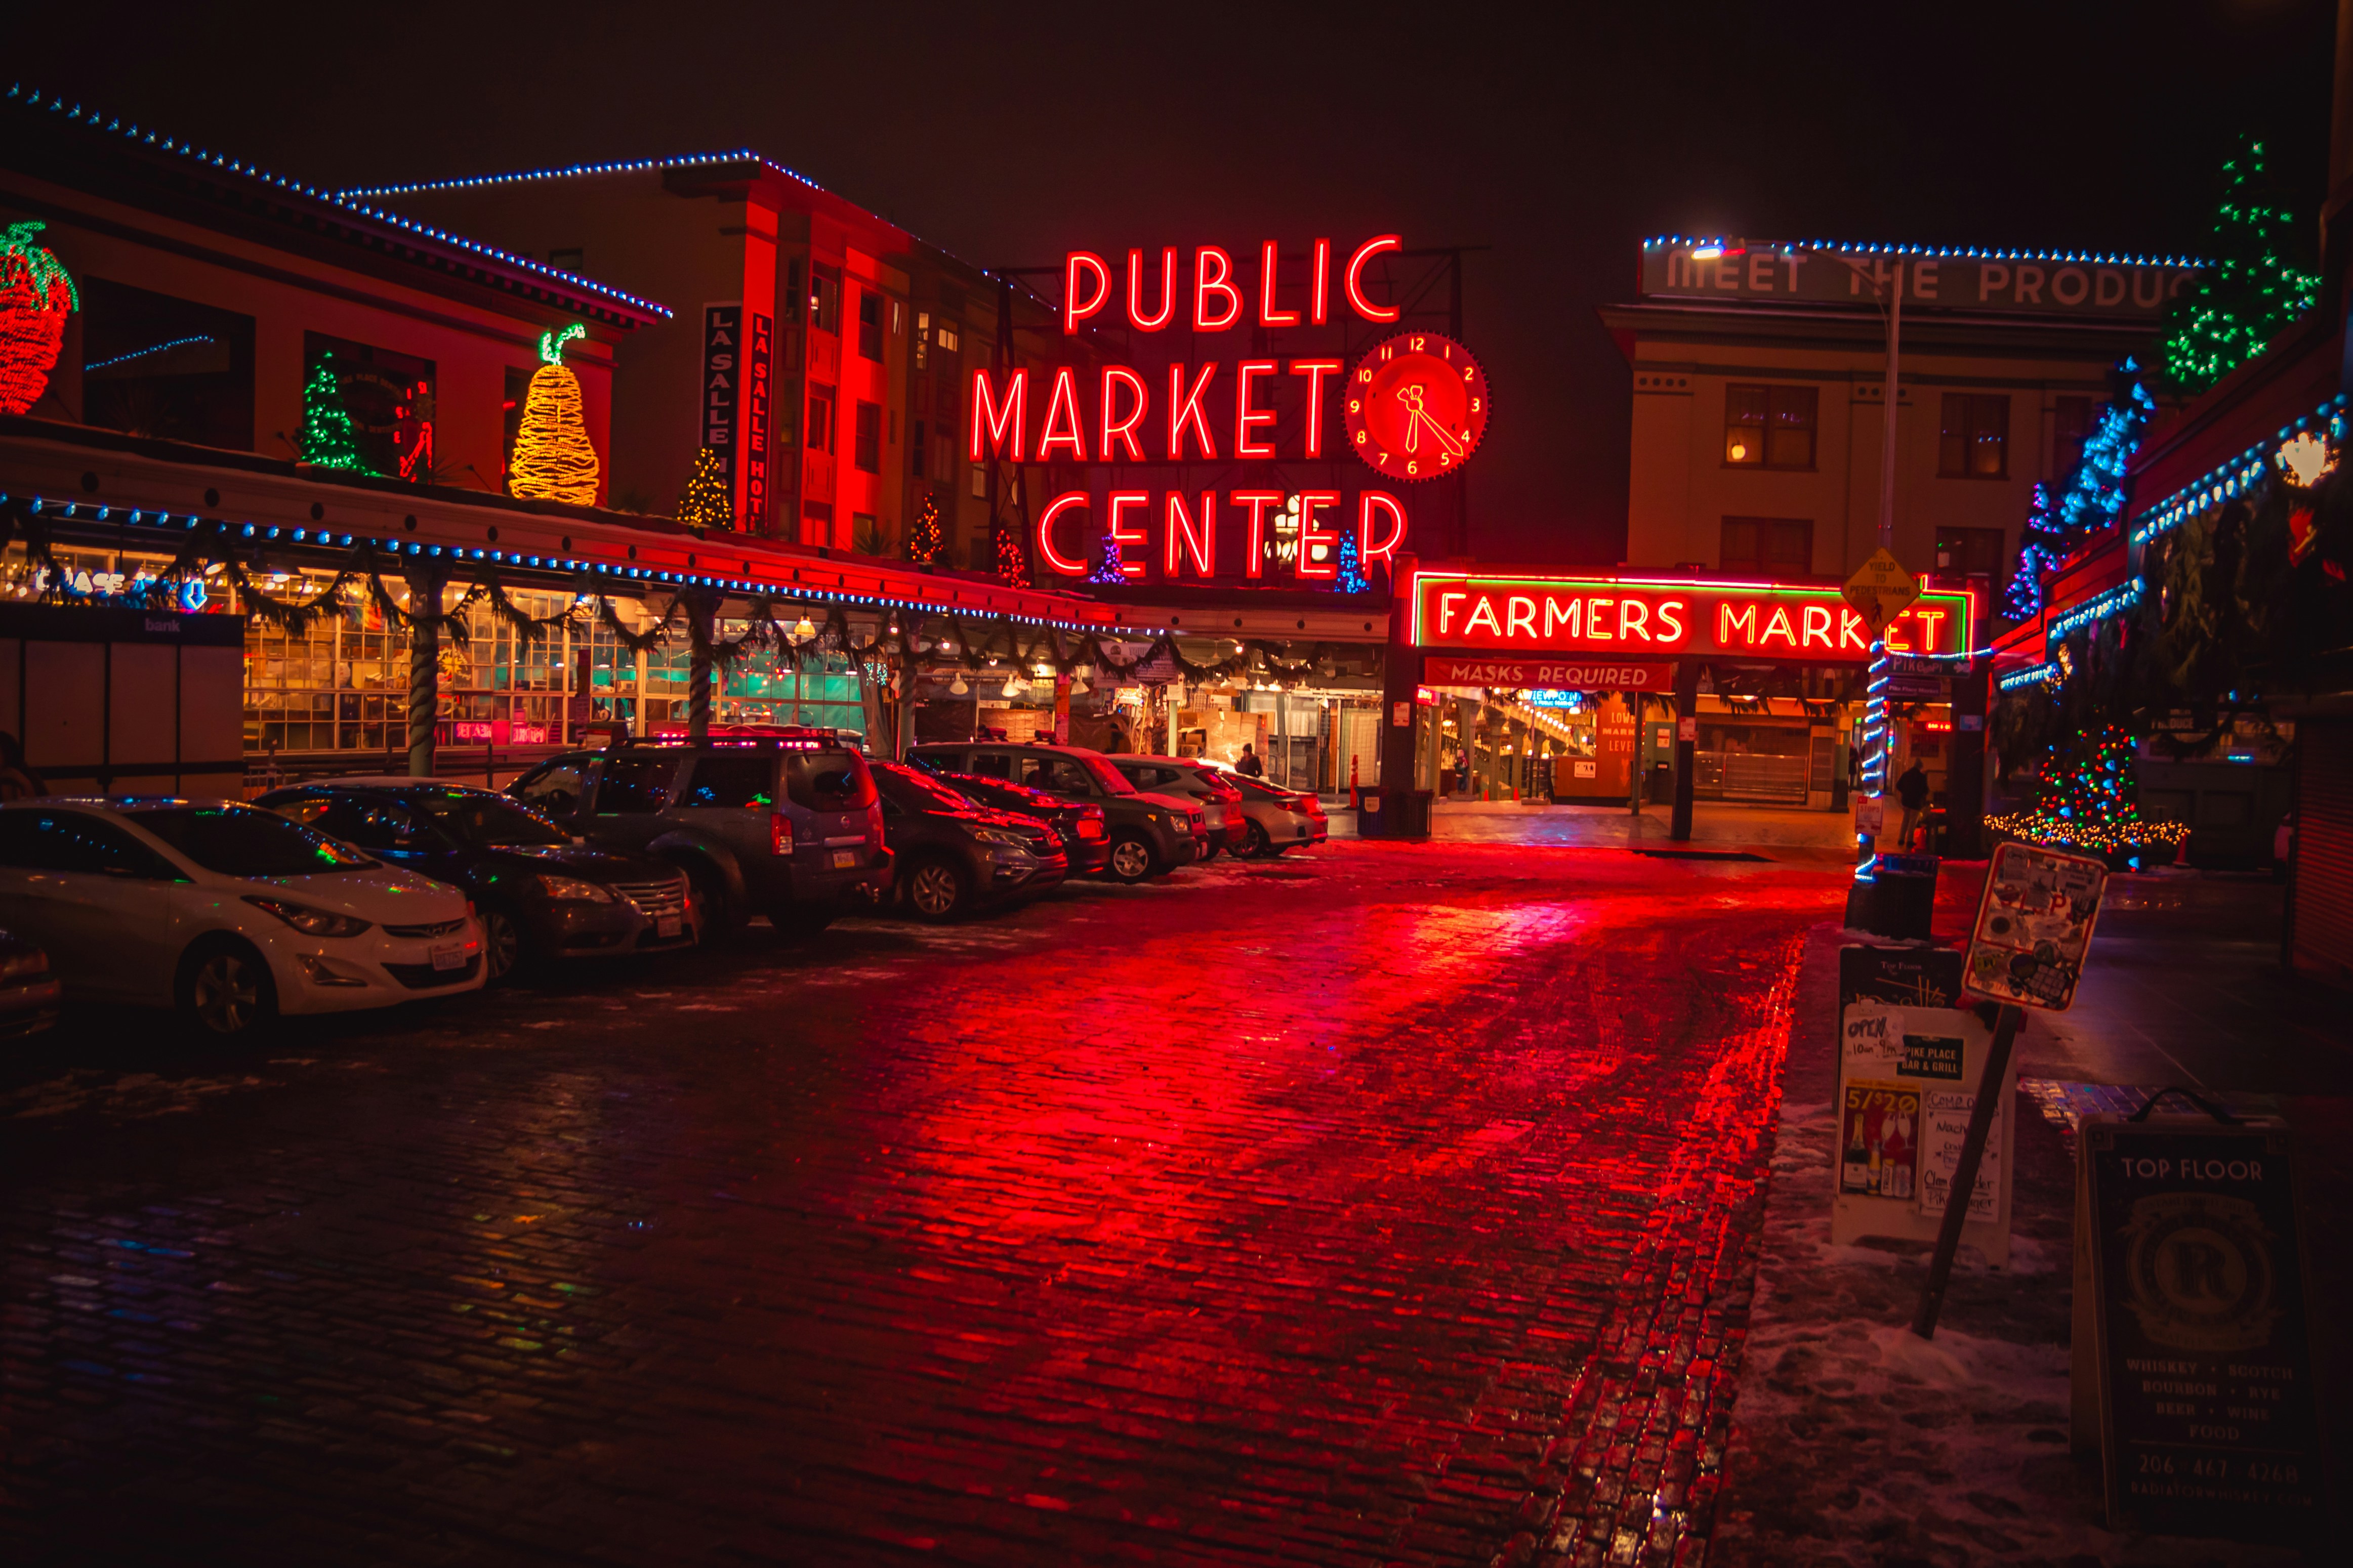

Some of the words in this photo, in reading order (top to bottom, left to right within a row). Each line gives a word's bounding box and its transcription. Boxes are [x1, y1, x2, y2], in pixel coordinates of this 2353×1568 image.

[1668, 249, 1808, 292] MEET
[1841, 257, 1938, 299] THE
[1064, 234, 1402, 335] PUBLIC
[1410, 337, 1424, 351] 12
[1381, 347, 1392, 360] 11
[1446, 346, 1449, 359] 1
[1359, 369, 1372, 383] 10
[1465, 367, 1473, 380] 2
[970, 358, 1344, 462] MARKET
[1350, 400, 1360, 413] 9
[1471, 398, 1480, 412] 3
[1356, 430, 1366, 444] 8
[1461, 430, 1470, 443] 4
[1379, 452, 1388, 465] 7
[1441, 452, 1449, 465] 5
[1408, 460, 1417, 474] 6
[1037, 489, 1408, 580] CENTER
[1869, 561, 1895, 572] YIELD
[1875, 574, 1886, 583] TO
[1850, 585, 1910, 597] PEDESTRIANS
[145, 618, 181, 632] bank
[1440, 592, 1683, 642] FARMERS
[1720, 603, 1945, 652] MARKET
[1893, 657, 1923, 672] Pike
[1452, 664, 1523, 682] MASKS
[1538, 666, 1648, 687] REQUIRED
[1611, 712, 1636, 724] LOWE
[1602, 728, 1635, 736] MARK
[1847, 1016, 1887, 1038] OPEN
[1905, 1046, 1925, 1057] PIKE
[1927, 1048, 1956, 1060] PLACE
[1902, 1061, 1919, 1071] BAR
[1923, 1062, 1929, 1071] &
[1932, 1063, 1958, 1073] GRILL
[2121, 1157, 2170, 1180] TOP
[2180, 1159, 2263, 1181] FLOOR
[1924, 1169, 1948, 1186] Clam
[2126, 1358, 2197, 1375] WHISKEY
[2228, 1364, 2293, 1380] SCOTCH
[2142, 1380, 2217, 1396] BOURBON
[2249, 1386, 2280, 1401] RYE
[2156, 1402, 2196, 1416] BEER
[2227, 1406, 2270, 1421] WINE
[2189, 1424, 2240, 1440] FOOD
[2139, 1454, 2174, 1474] 206
[2193, 1458, 2228, 1478] 467
[2247, 1463, 2299, 1485] 4268
